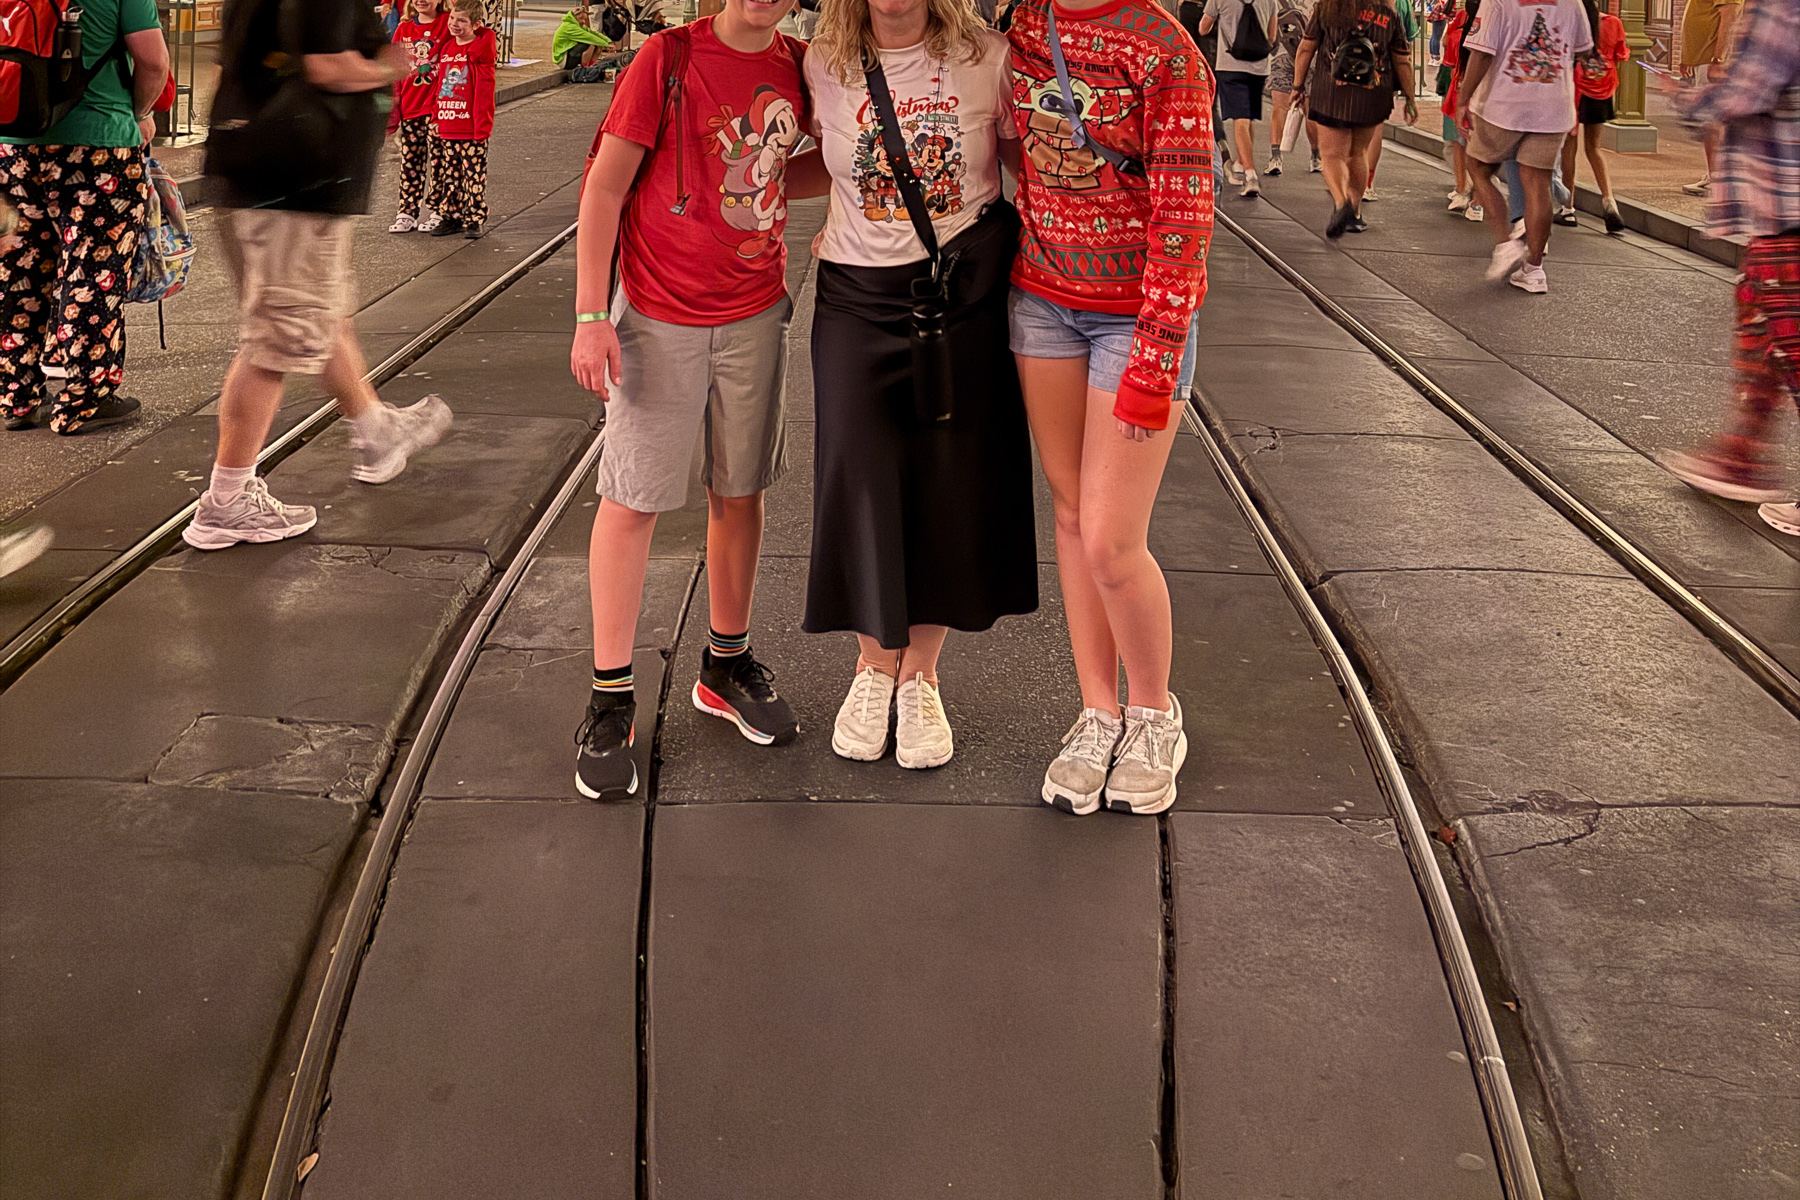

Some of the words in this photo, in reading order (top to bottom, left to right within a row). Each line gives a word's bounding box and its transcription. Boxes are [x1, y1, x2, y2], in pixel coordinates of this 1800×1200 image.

[1084, 61, 1116, 75] BRIGHT
[437, 110, 470, 120] OOD-ish
[1098, 194, 1114, 204] THE
[1159, 210, 1182, 219] THIS
[1183, 211, 1194, 220] IS
